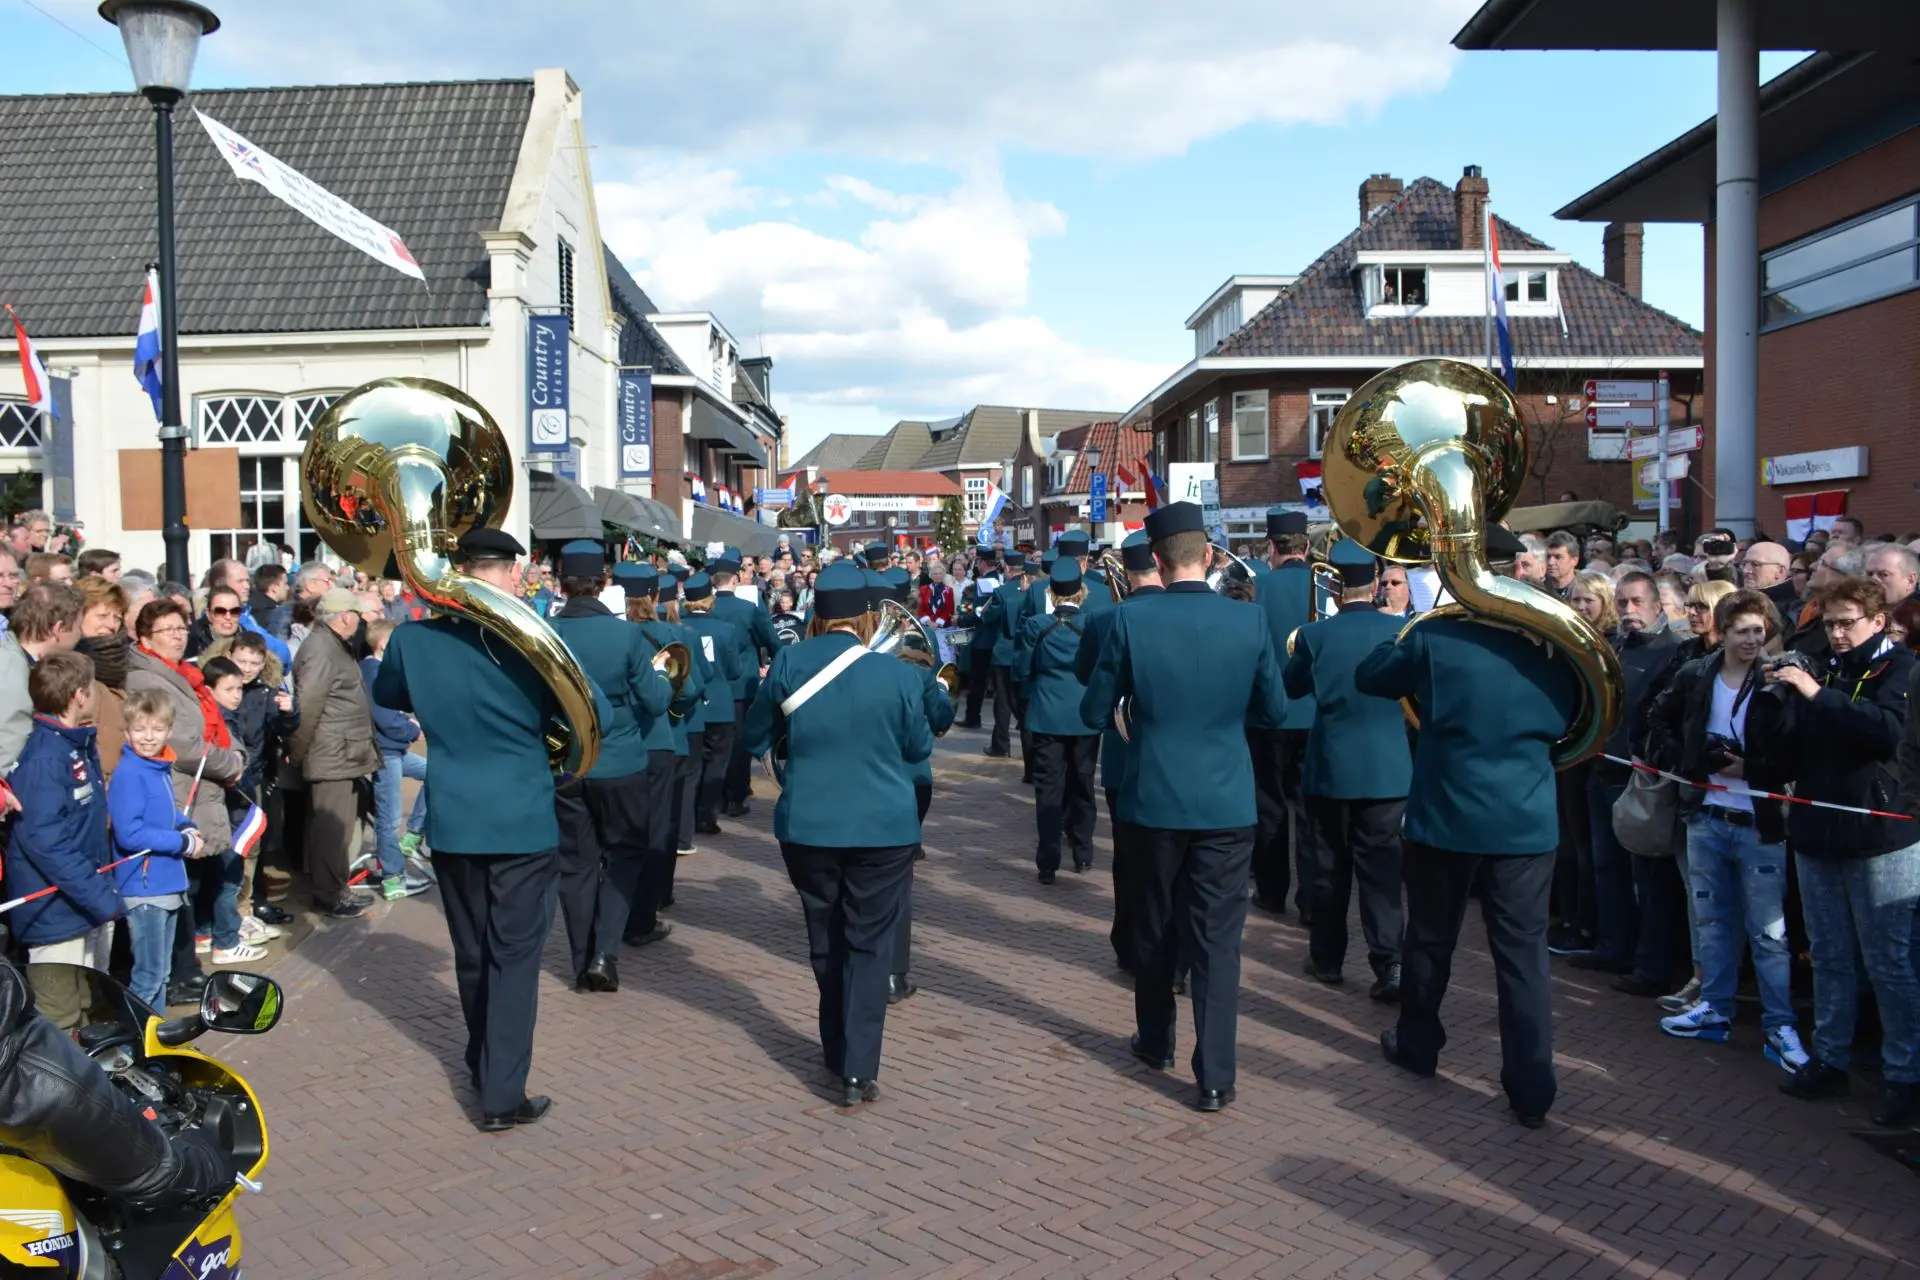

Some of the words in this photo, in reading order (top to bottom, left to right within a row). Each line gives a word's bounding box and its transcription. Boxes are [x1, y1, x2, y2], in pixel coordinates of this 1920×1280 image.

[532, 324, 556, 405] Country
[553, 350, 562, 405] wishes
[623, 380, 641, 443] Country
[639, 400, 647, 442] wishes
[1093, 475, 1103, 487] P
[1093, 502, 1103, 515] P
[27, 1235, 74, 1256] HONDA
[199, 1247, 230, 1280] 900
